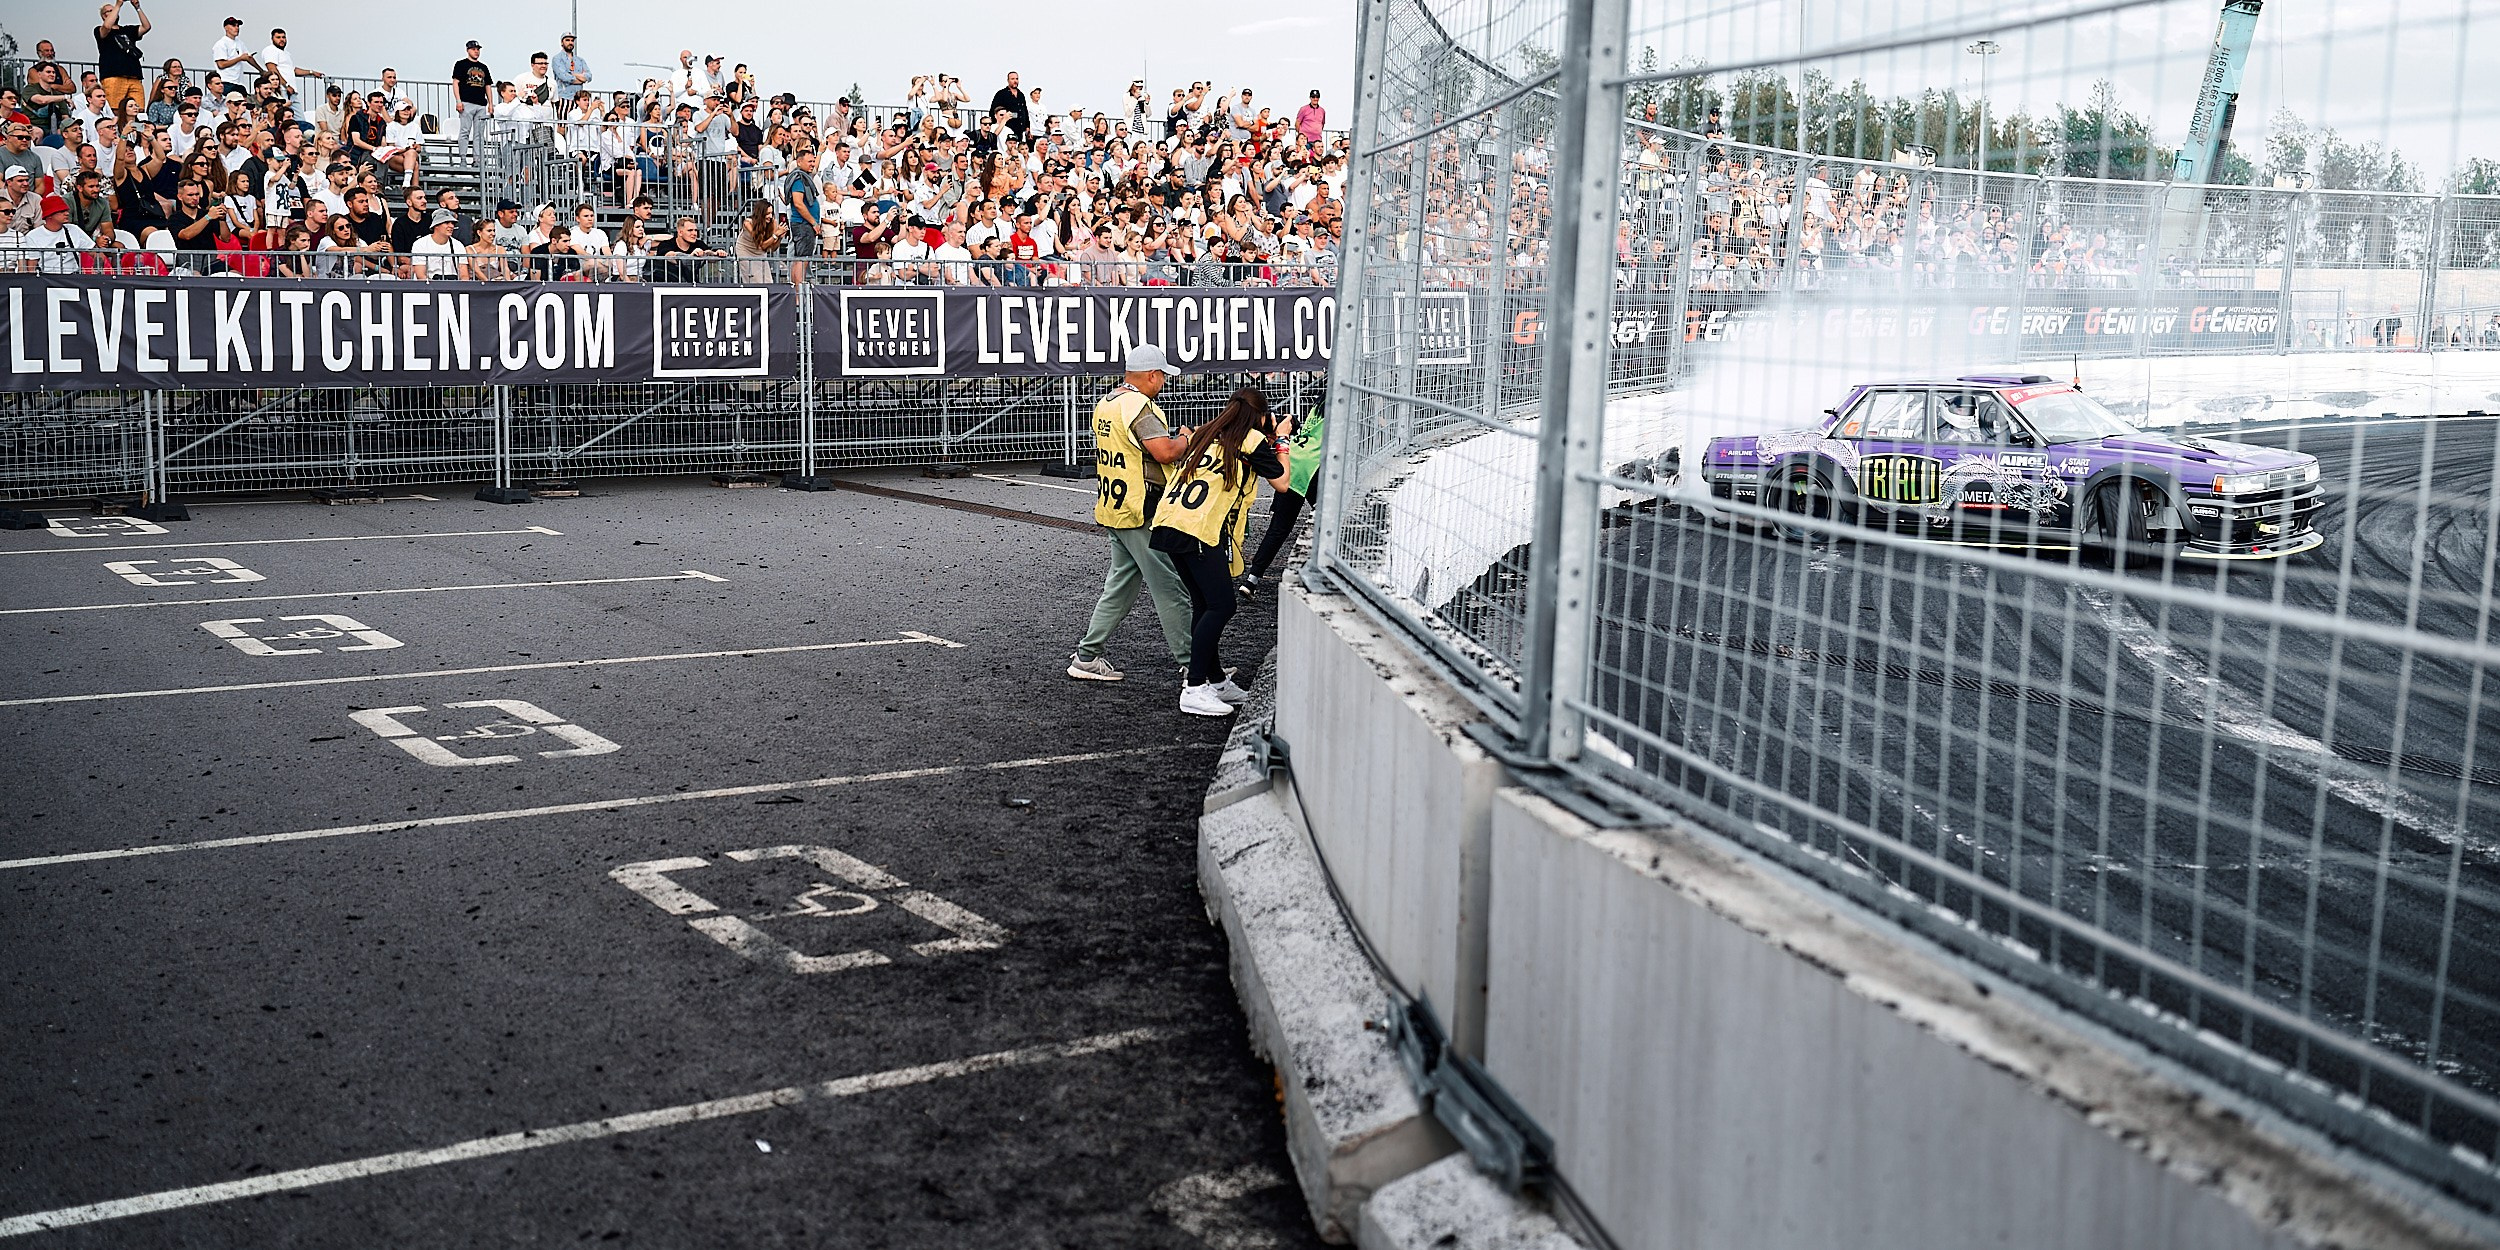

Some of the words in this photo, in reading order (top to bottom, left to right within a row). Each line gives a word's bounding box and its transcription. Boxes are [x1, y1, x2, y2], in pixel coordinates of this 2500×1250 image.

[2218, 47, 2231, 66] 9111
[2213, 67, 2225, 83] 000
[2190, 54, 2219, 137] AVTOVYSHKA-SPB.RU
[2209, 85, 2220, 100] 991
[2197, 109, 2214, 146] АРЕНДА
[9, 286, 616, 374] LEVELKITCHEN.COM
[671, 341, 752, 357] KITCHEN
[857, 341, 931, 356] KITCHEN
[2000, 455, 2045, 467] AIMOL
[2068, 457, 2091, 466] START
[2068, 466, 2090, 475] VOLT
[1861, 457, 1937, 501] TRIALLI
[1166, 479, 1210, 510] 40
